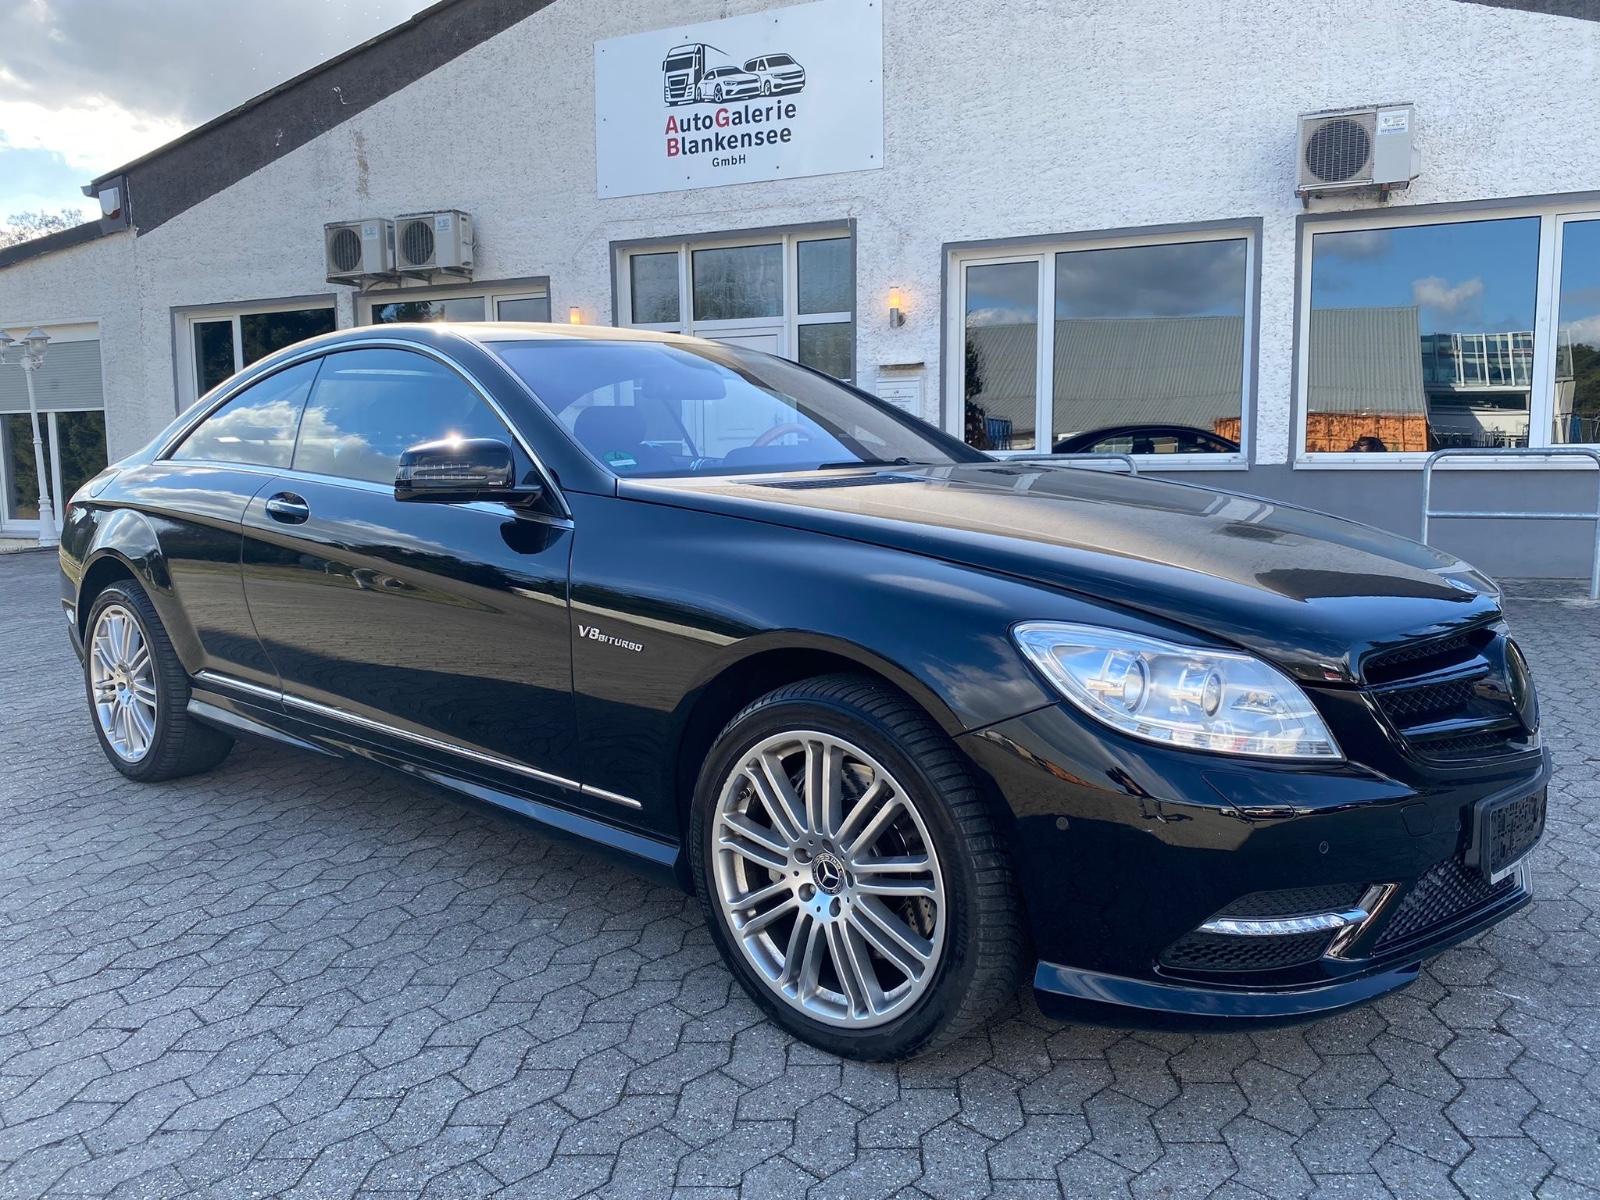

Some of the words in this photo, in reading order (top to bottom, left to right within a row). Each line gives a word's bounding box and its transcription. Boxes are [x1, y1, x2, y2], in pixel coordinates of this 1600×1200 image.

[665, 100, 796, 135] AutoGalerie
[667, 127, 792, 157] Blankensee
[712, 154, 746, 167] GmbH
